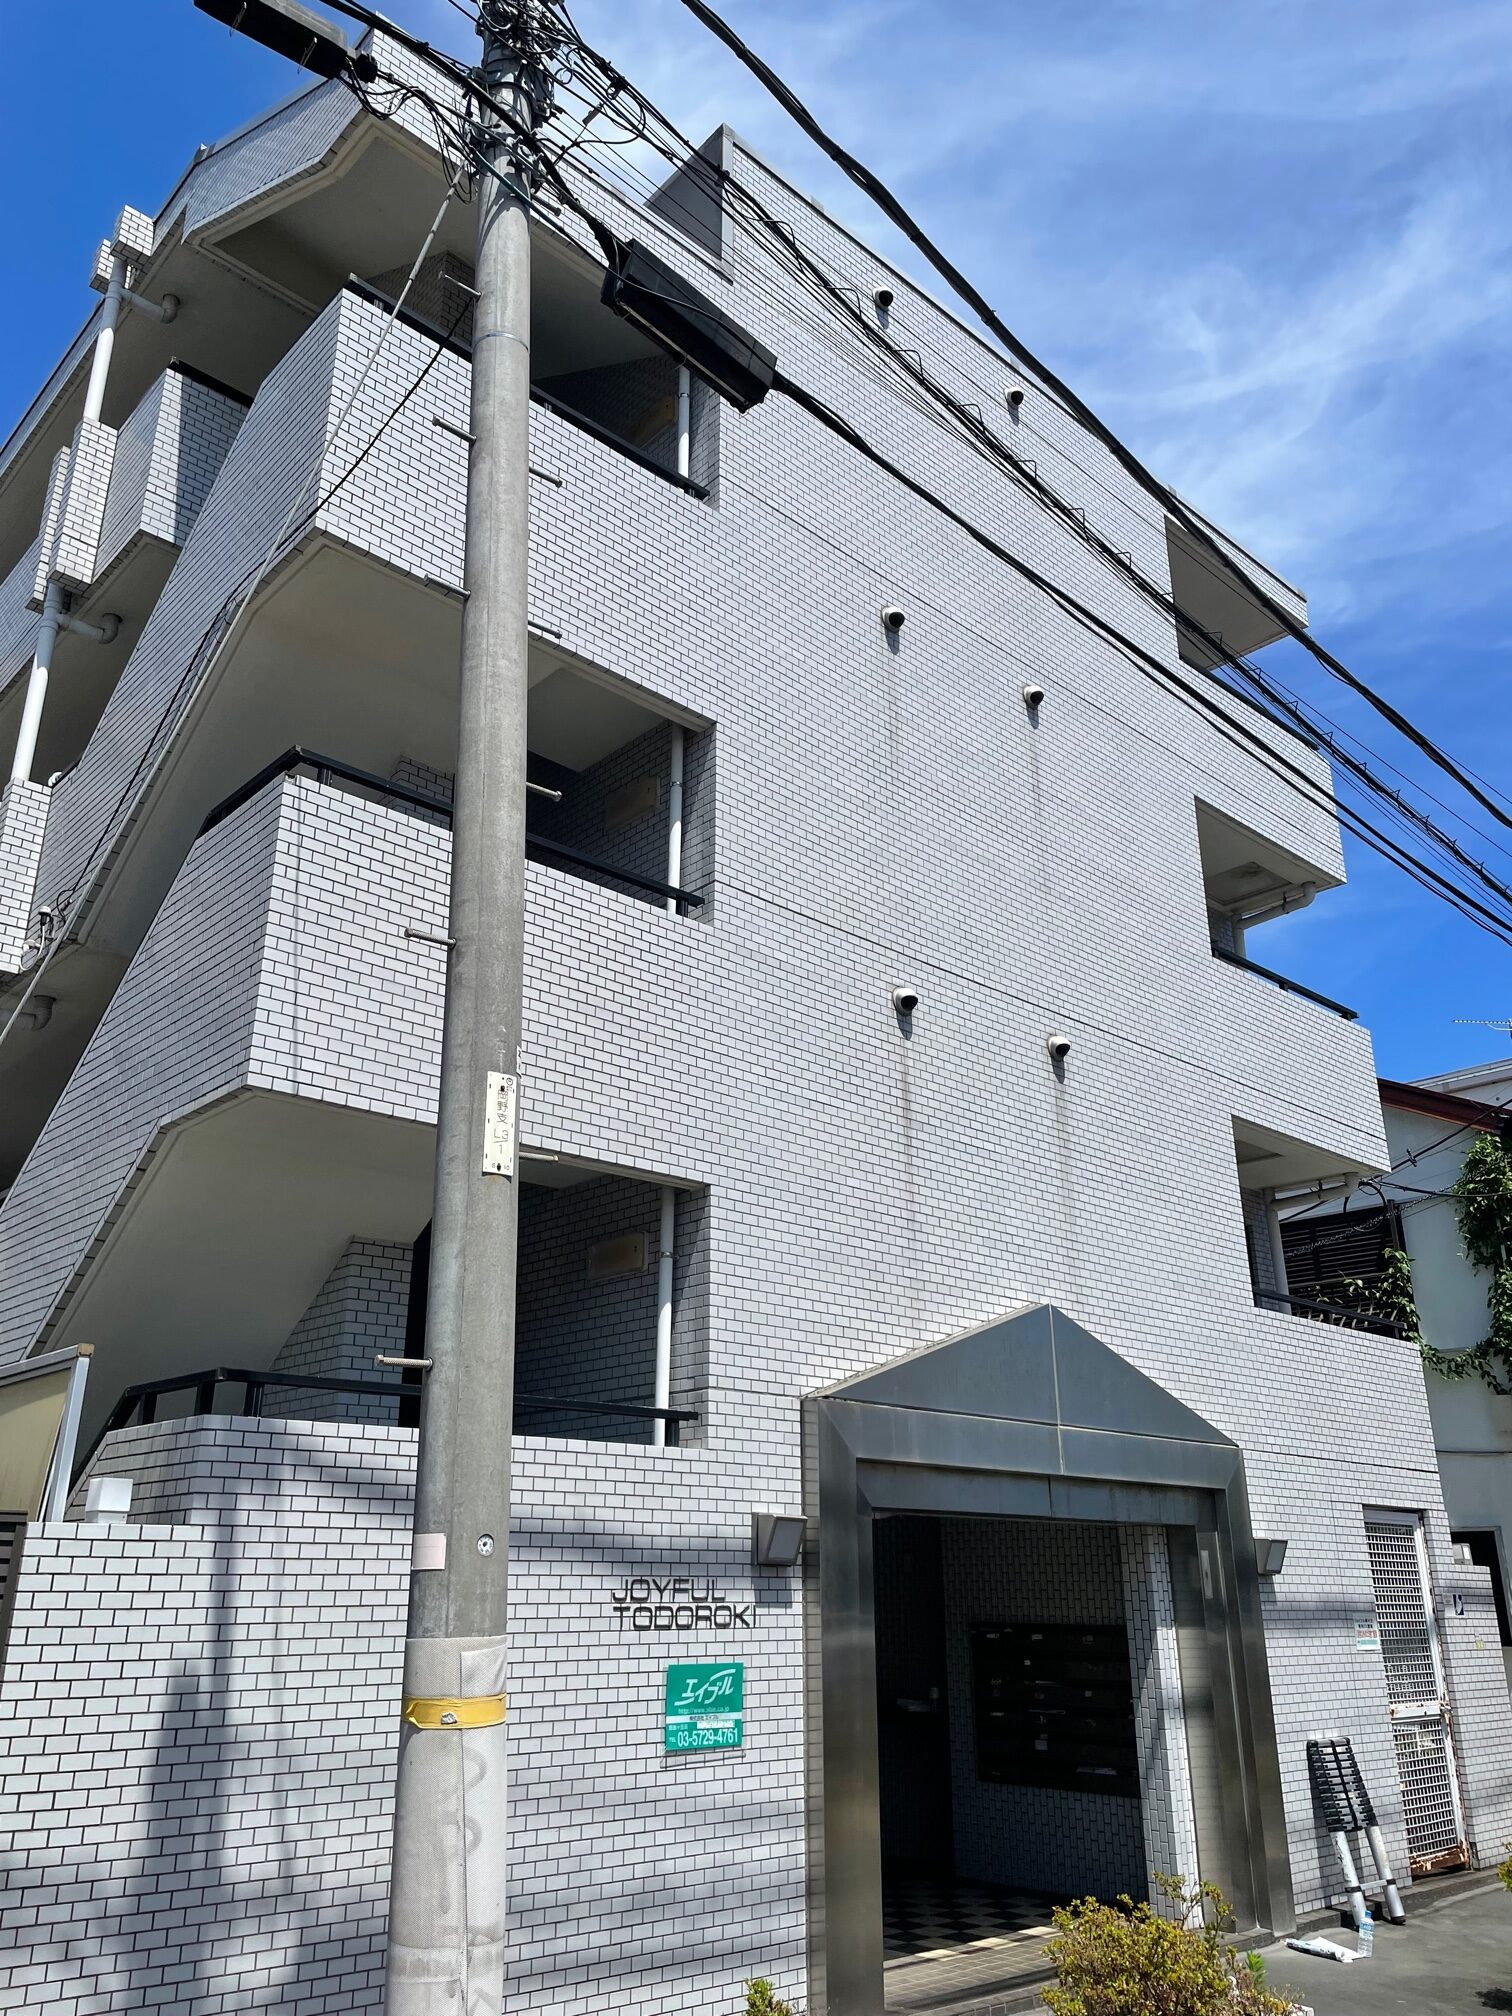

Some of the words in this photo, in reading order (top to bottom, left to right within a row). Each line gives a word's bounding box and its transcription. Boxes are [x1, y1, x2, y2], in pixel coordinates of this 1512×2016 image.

[612, 1579, 726, 1603] JOYFUL
[612, 1605, 756, 1631] TODOROKI
[674, 1668, 736, 1706] エイブル
[677, 1728, 738, 1747] 03-5729-4761
